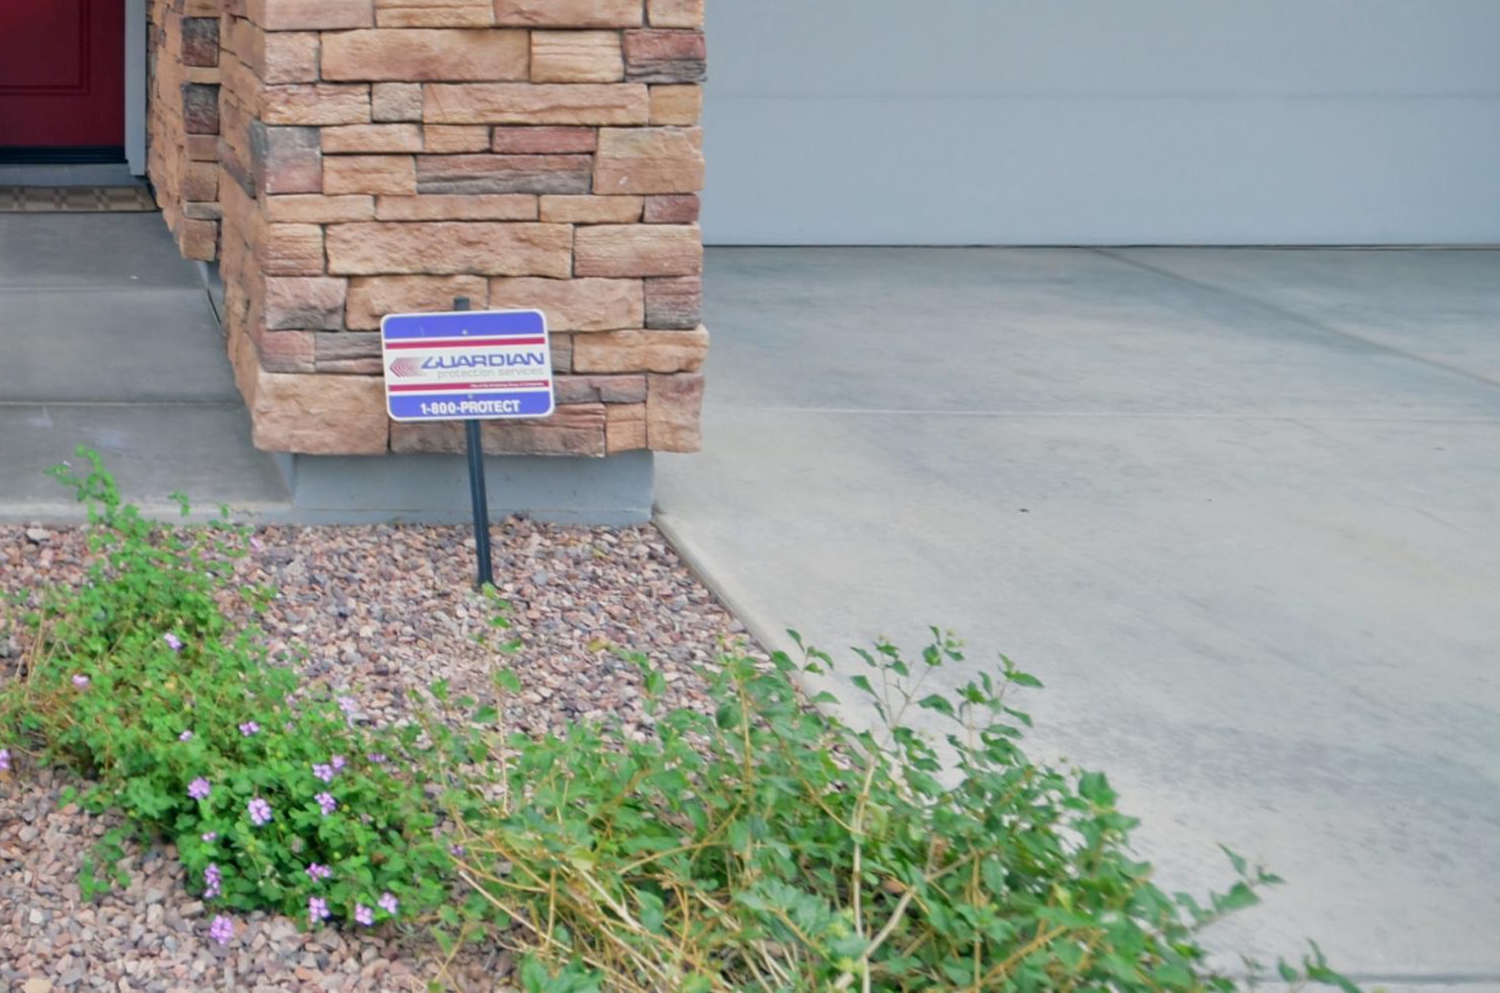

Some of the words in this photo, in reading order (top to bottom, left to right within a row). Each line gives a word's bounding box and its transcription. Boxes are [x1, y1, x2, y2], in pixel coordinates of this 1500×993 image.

[421, 353, 544, 369] GUARDIAN
[437, 367, 494, 379] protection
[498, 367, 544, 377] services
[420, 399, 521, 415] 1-800-PROTECT
